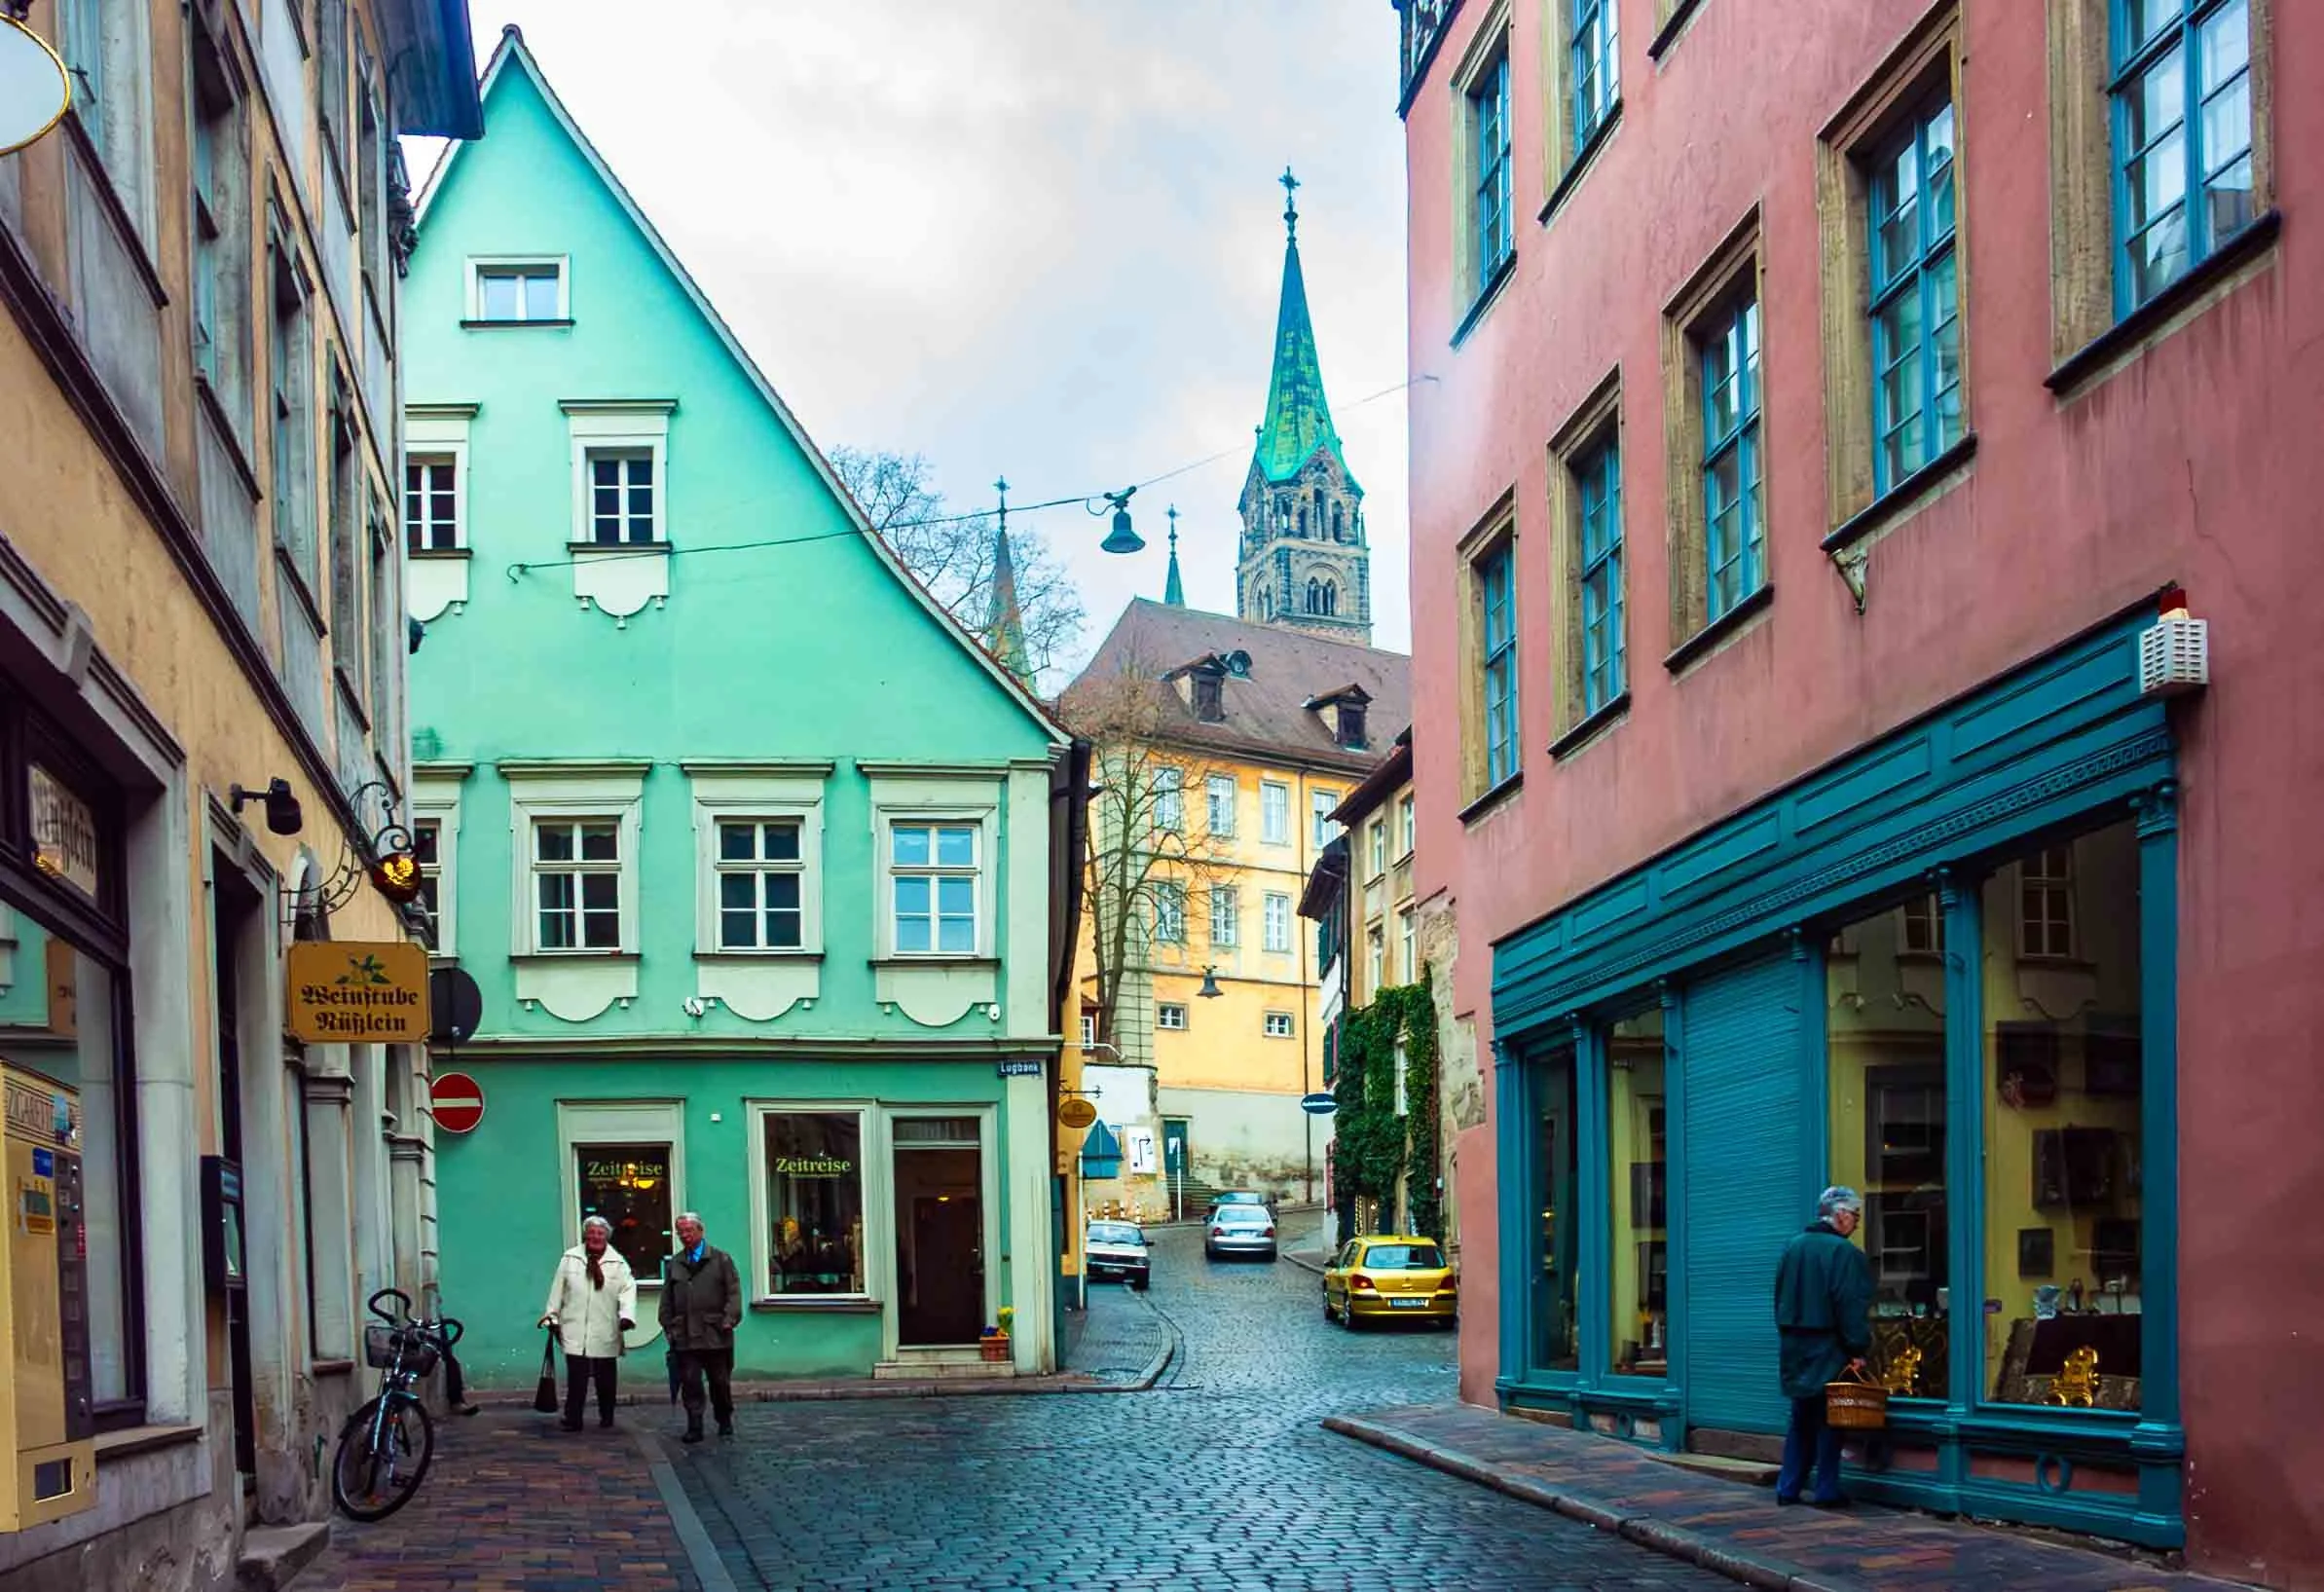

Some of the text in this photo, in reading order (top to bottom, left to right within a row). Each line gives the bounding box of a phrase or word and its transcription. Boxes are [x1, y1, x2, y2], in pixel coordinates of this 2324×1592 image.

[301, 983, 419, 1010] Weinstube
[586, 1160, 663, 1176] Zeitrise
[776, 1156, 852, 1173] Zeitreise
